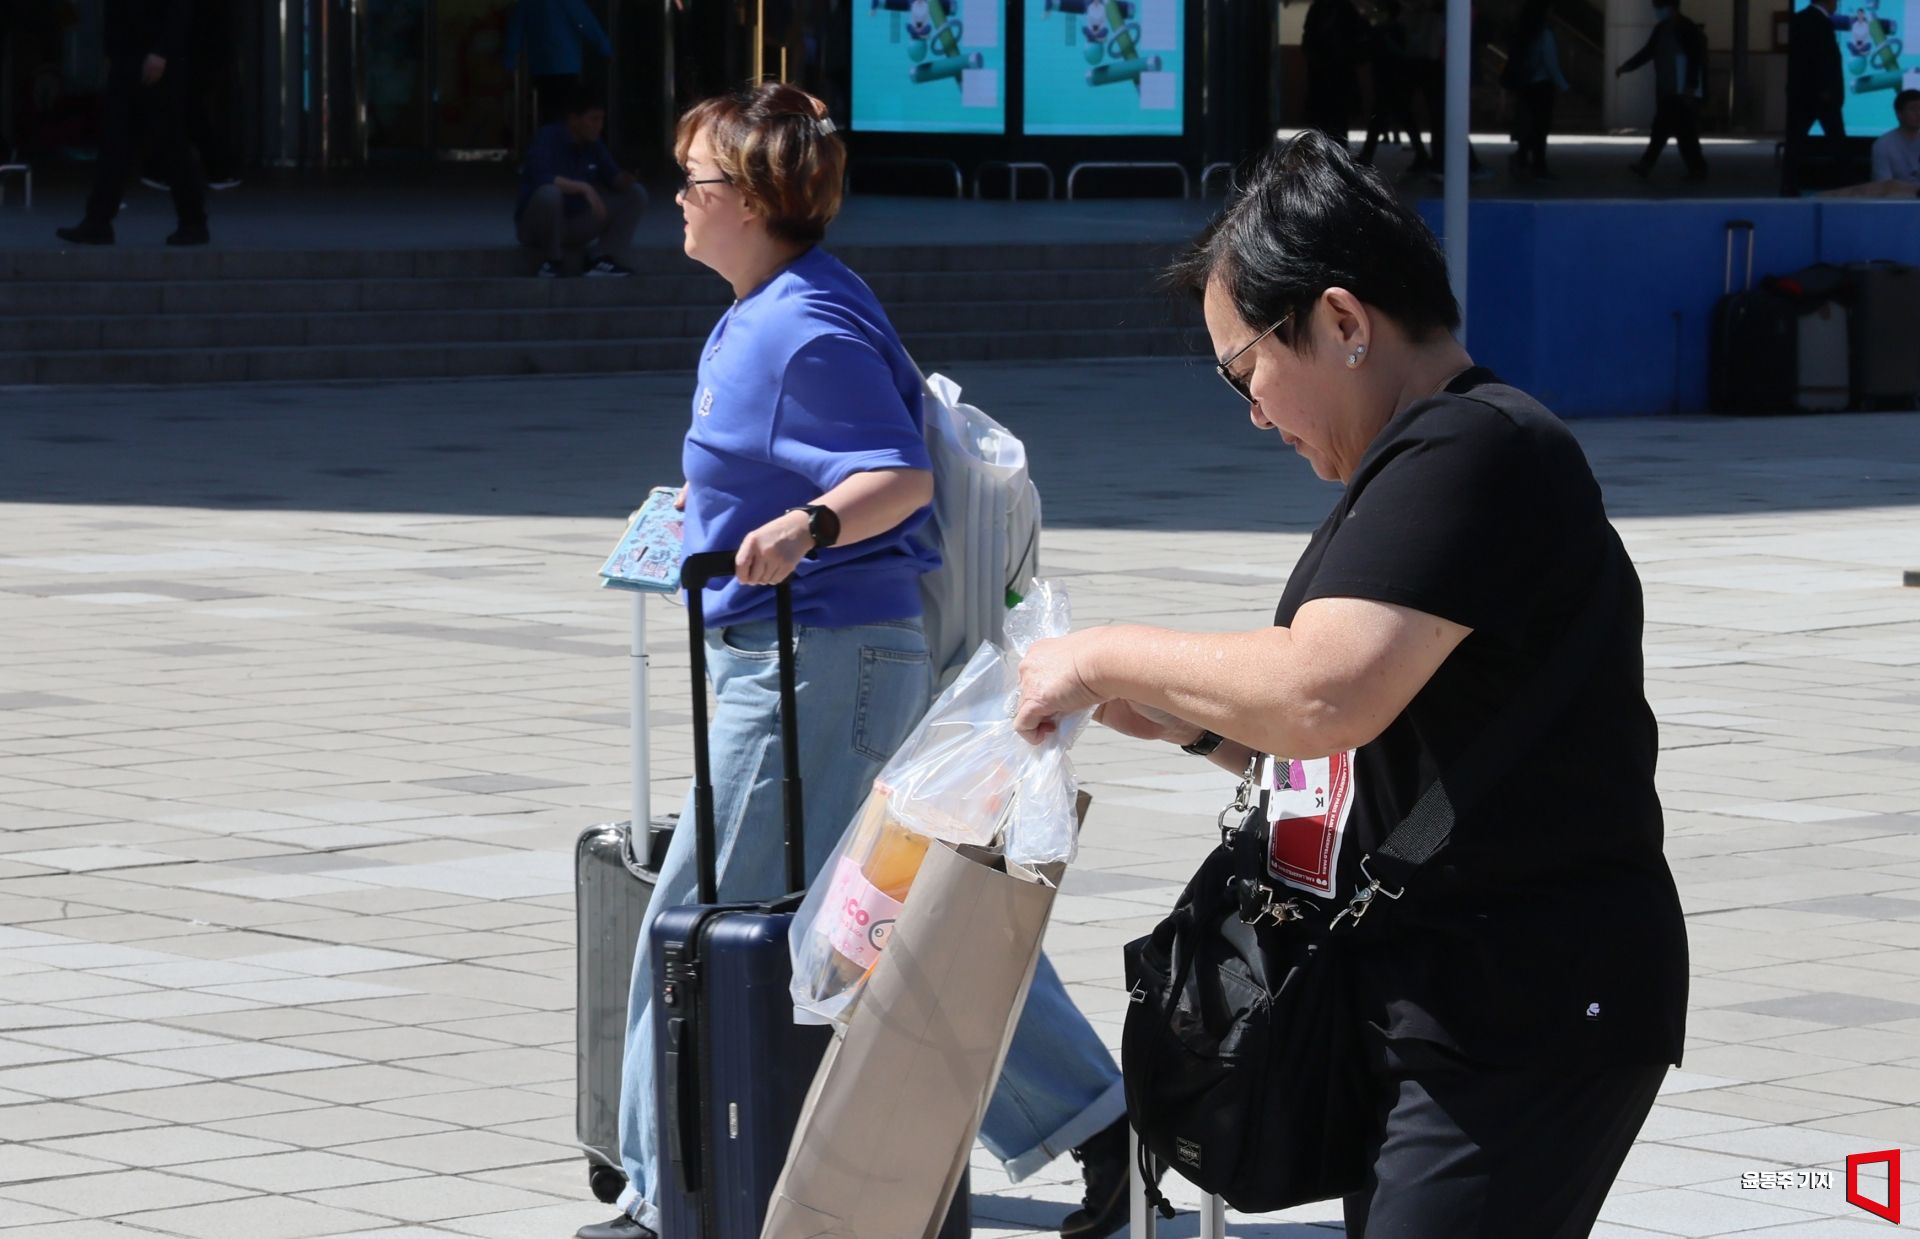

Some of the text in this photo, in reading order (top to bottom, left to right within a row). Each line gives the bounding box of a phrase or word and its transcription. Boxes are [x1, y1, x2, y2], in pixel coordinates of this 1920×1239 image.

[1337, 768, 1347, 798] LAGERFELD
[1315, 797, 1324, 808] K
[1331, 797, 1341, 813] PARIS
